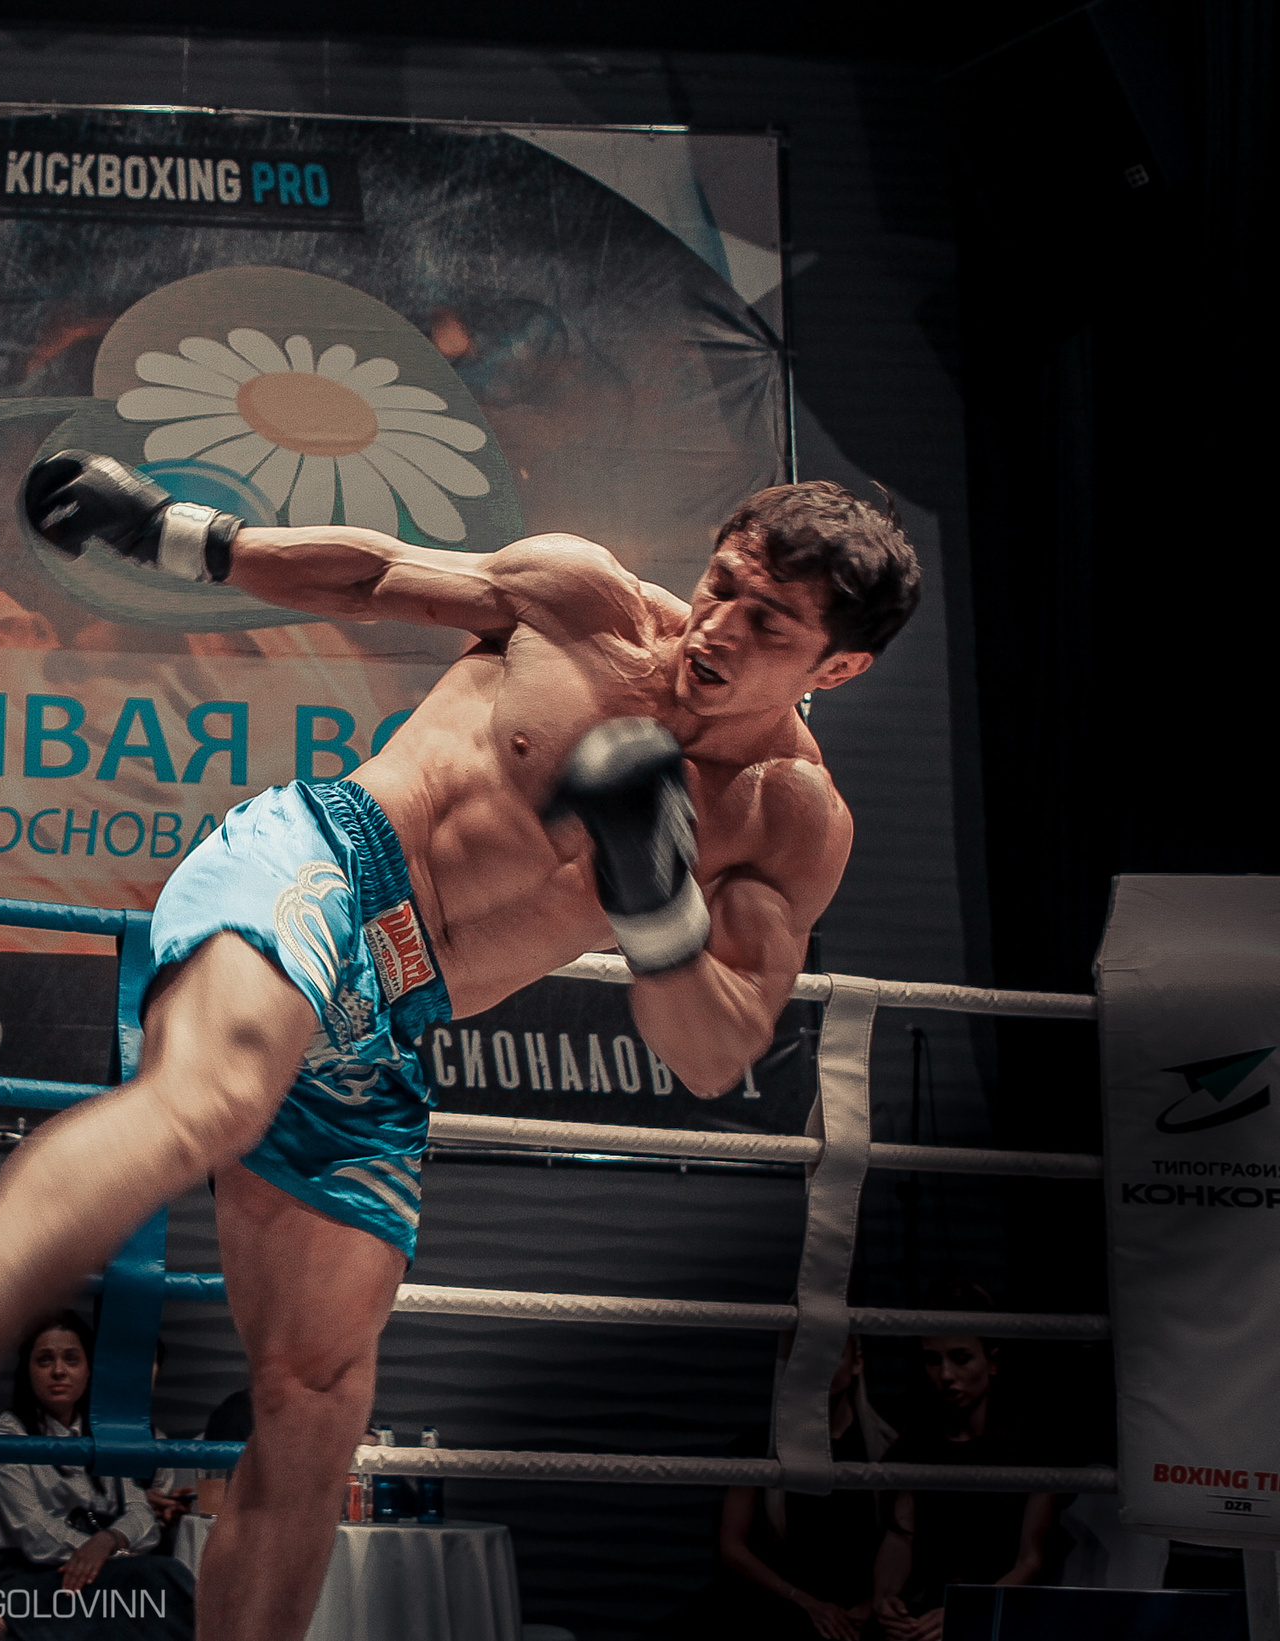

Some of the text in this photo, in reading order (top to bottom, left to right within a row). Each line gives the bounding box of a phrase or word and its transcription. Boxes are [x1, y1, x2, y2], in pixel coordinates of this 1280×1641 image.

[4, 150, 242, 202] KICKBOXING
[251, 160, 331, 206] PRO
[381, 948, 398, 980] STAR
[1151, 1160, 1280, 1179] ТИПОГРАФИ
[1153, 1463, 1280, 1492] BOXING TI
[1224, 1500, 1252, 1512] DZR
